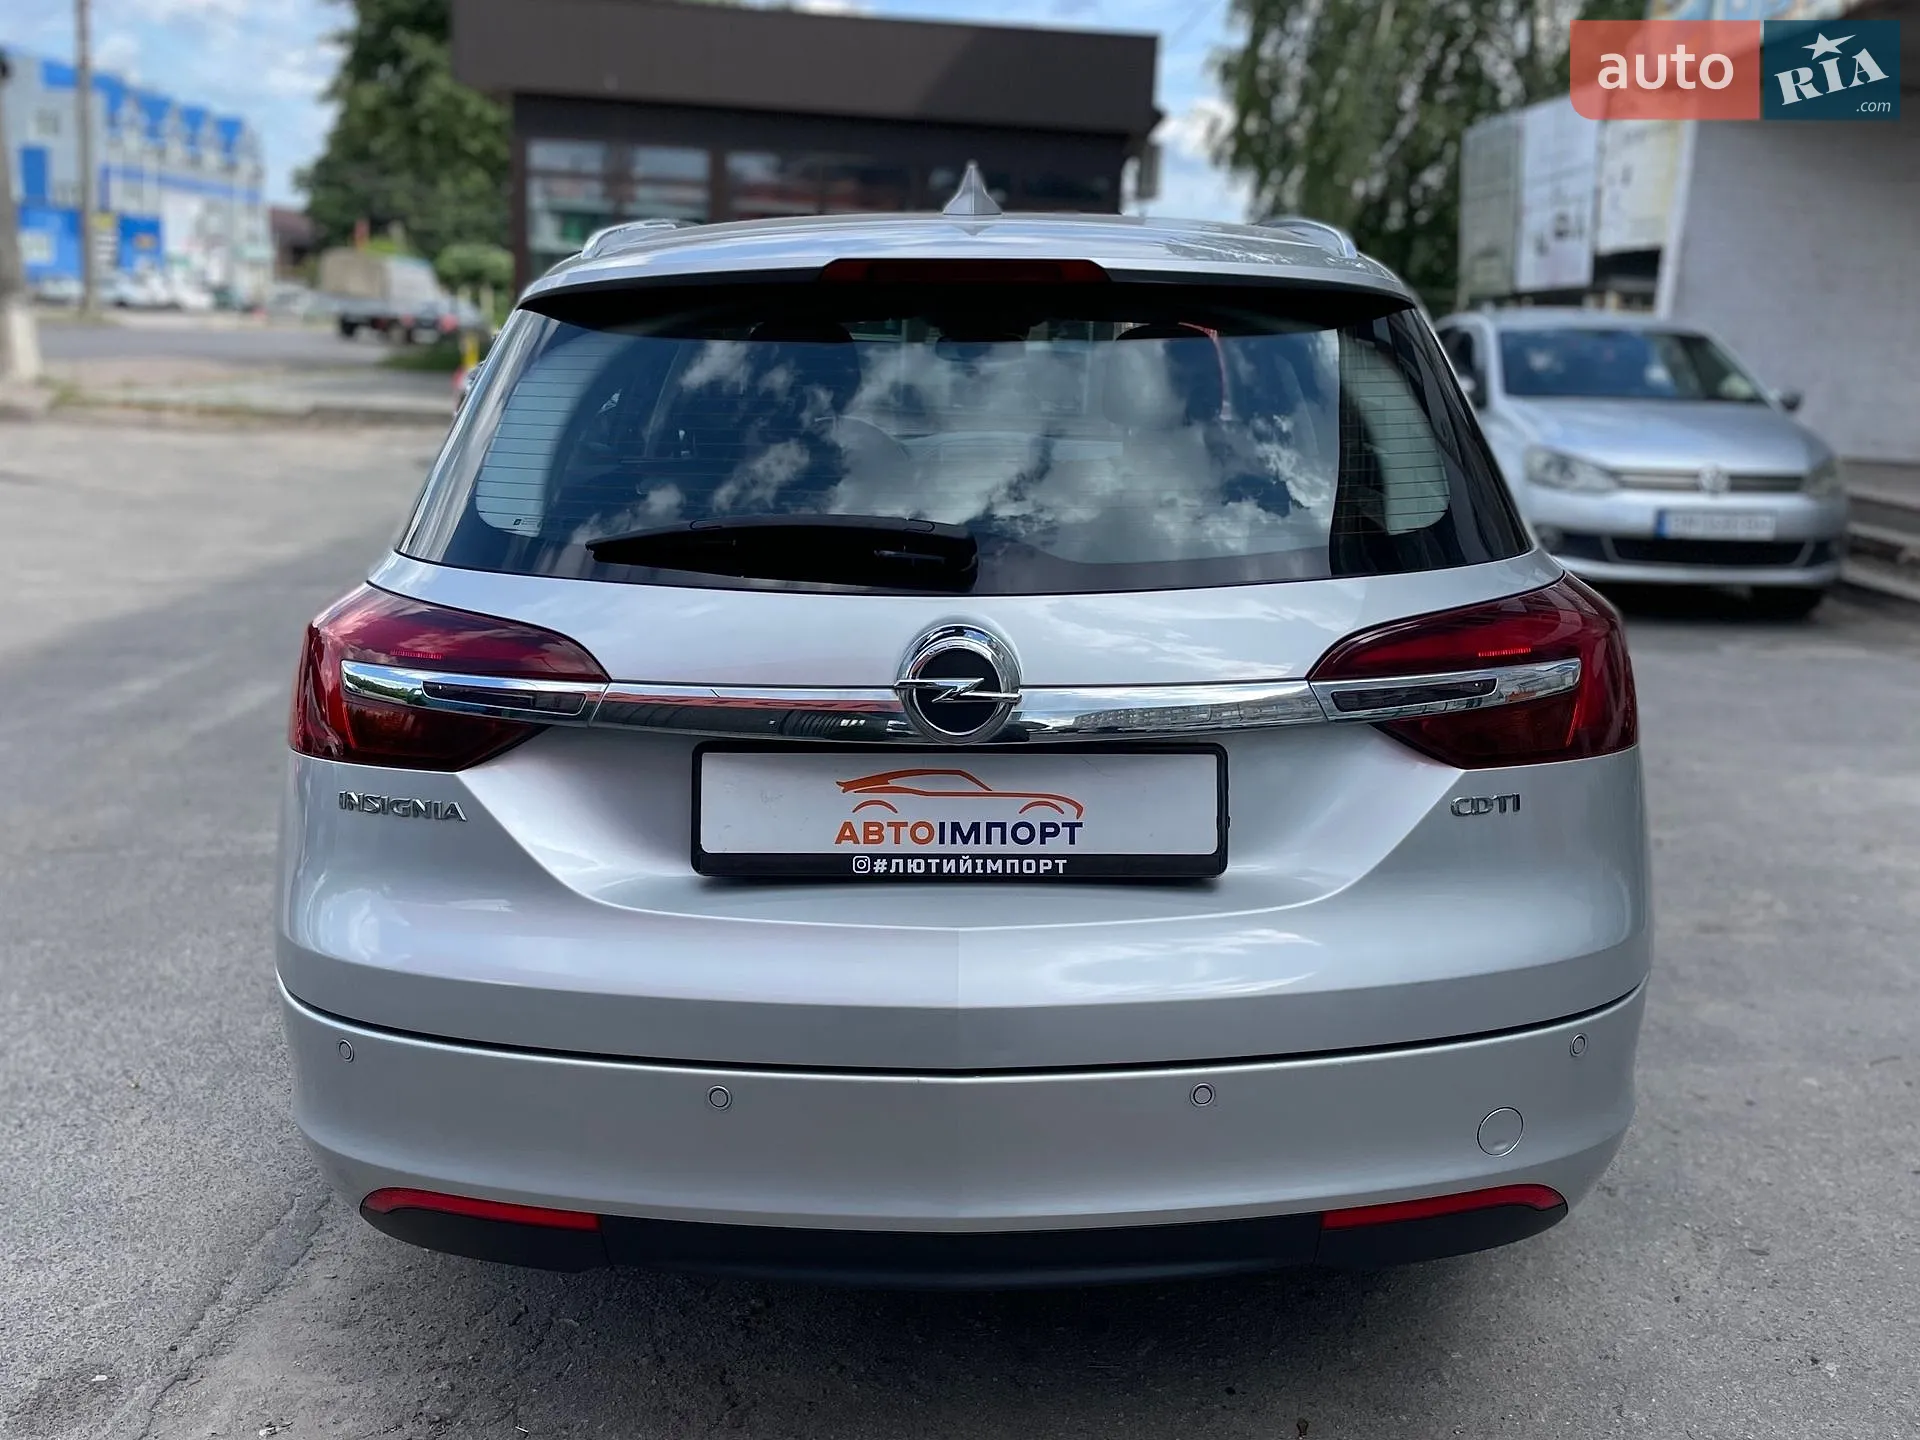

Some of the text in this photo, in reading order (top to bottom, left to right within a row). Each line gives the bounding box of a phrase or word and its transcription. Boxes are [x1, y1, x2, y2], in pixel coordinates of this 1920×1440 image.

[338, 790, 468, 822] INSIGNIA
[1450, 792, 1520, 817] CDTI
[834, 821, 1083, 845] АВТОІМПОРТ
